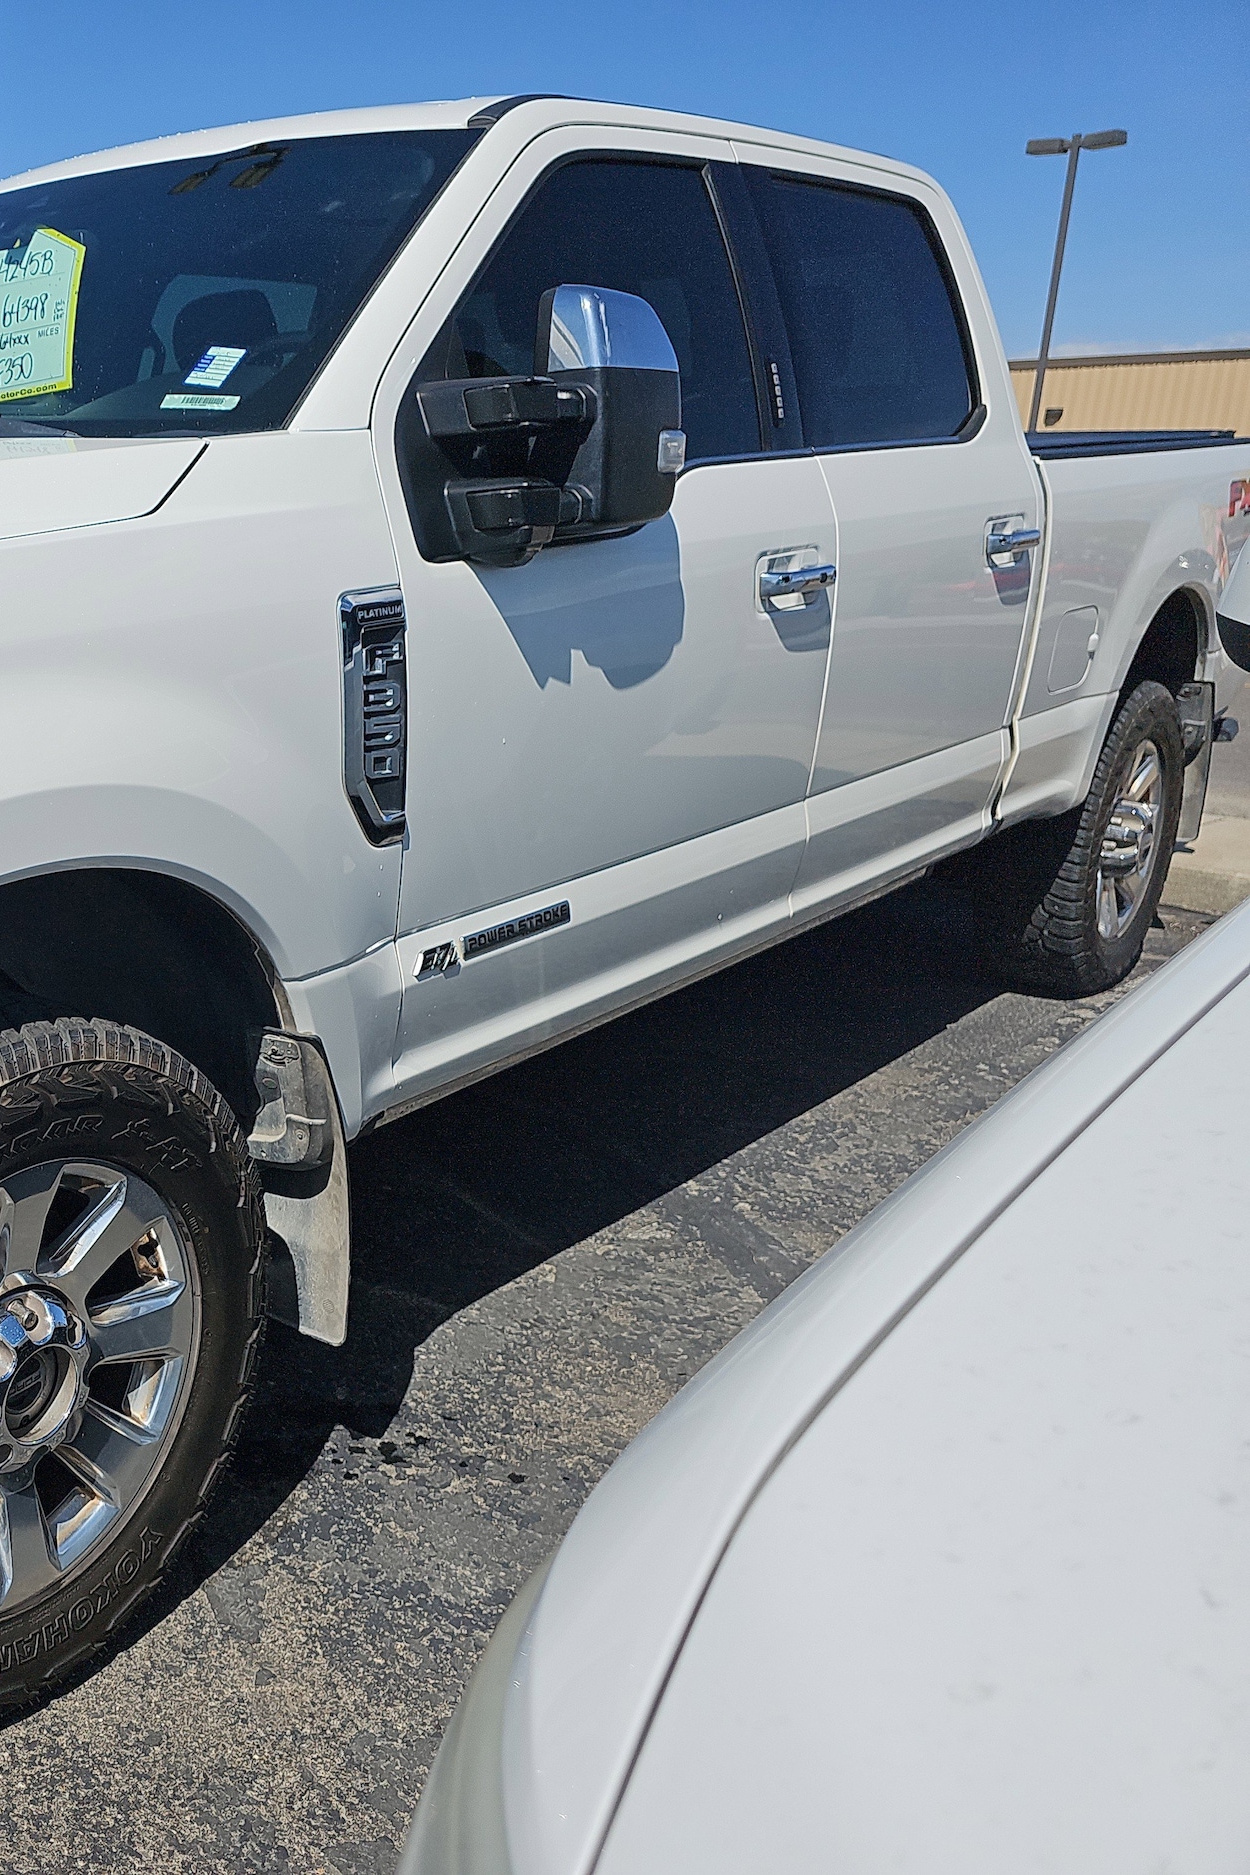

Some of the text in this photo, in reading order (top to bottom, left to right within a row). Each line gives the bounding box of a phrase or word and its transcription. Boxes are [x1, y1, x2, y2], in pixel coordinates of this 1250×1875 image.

[37, 326, 59, 338] MILES
[358, 603, 402, 621] PLATINUM
[467, 922, 516, 951] POWER
[517, 903, 569, 936] STROKE
